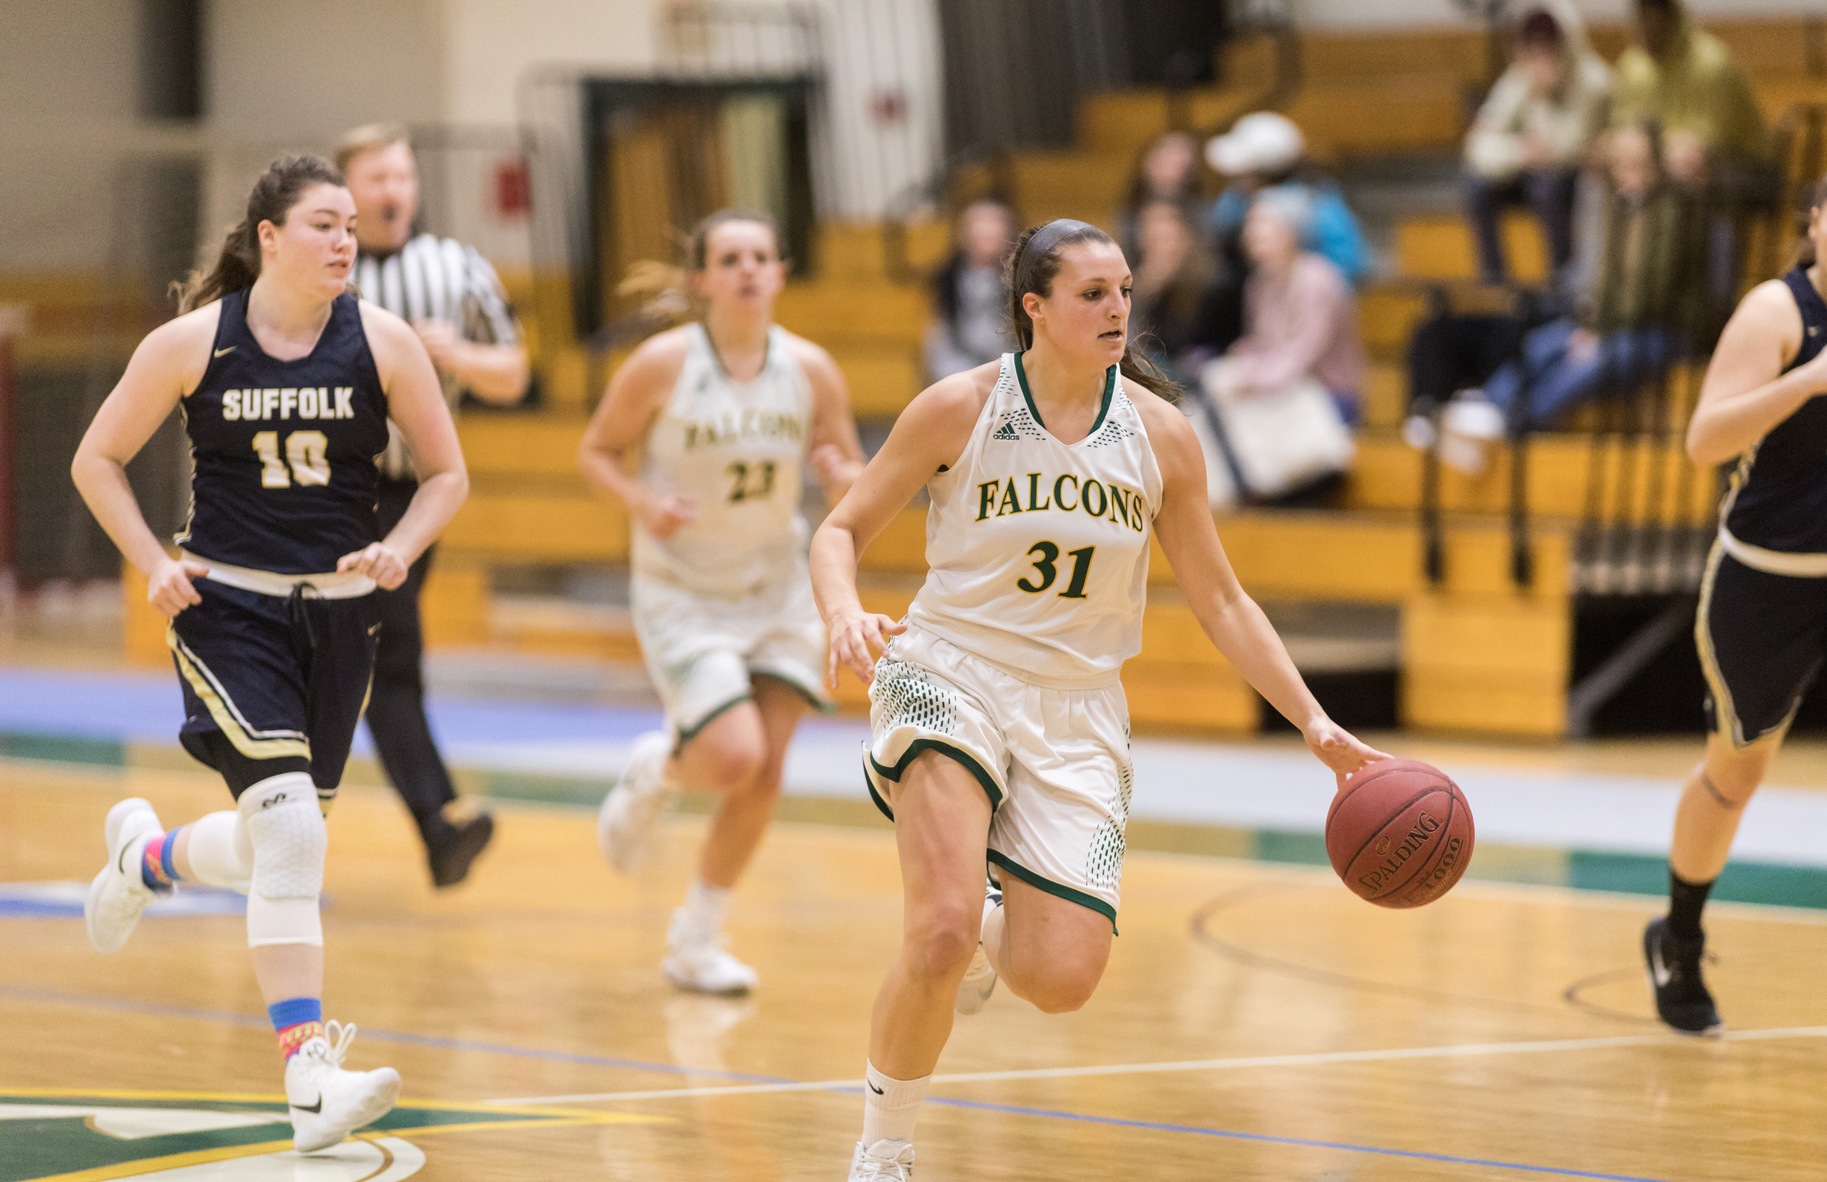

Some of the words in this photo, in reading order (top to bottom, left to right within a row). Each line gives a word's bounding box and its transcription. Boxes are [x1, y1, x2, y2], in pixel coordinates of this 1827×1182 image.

[222, 387, 354, 420] SUFFOLK
[685, 409, 802, 453] FALCON
[252, 430, 331, 489] 10
[993, 433, 1020, 441] adidas
[975, 472, 1144, 532] FALCONS
[1017, 540, 1097, 599] 31
[1358, 810, 1441, 893] SPALDING
